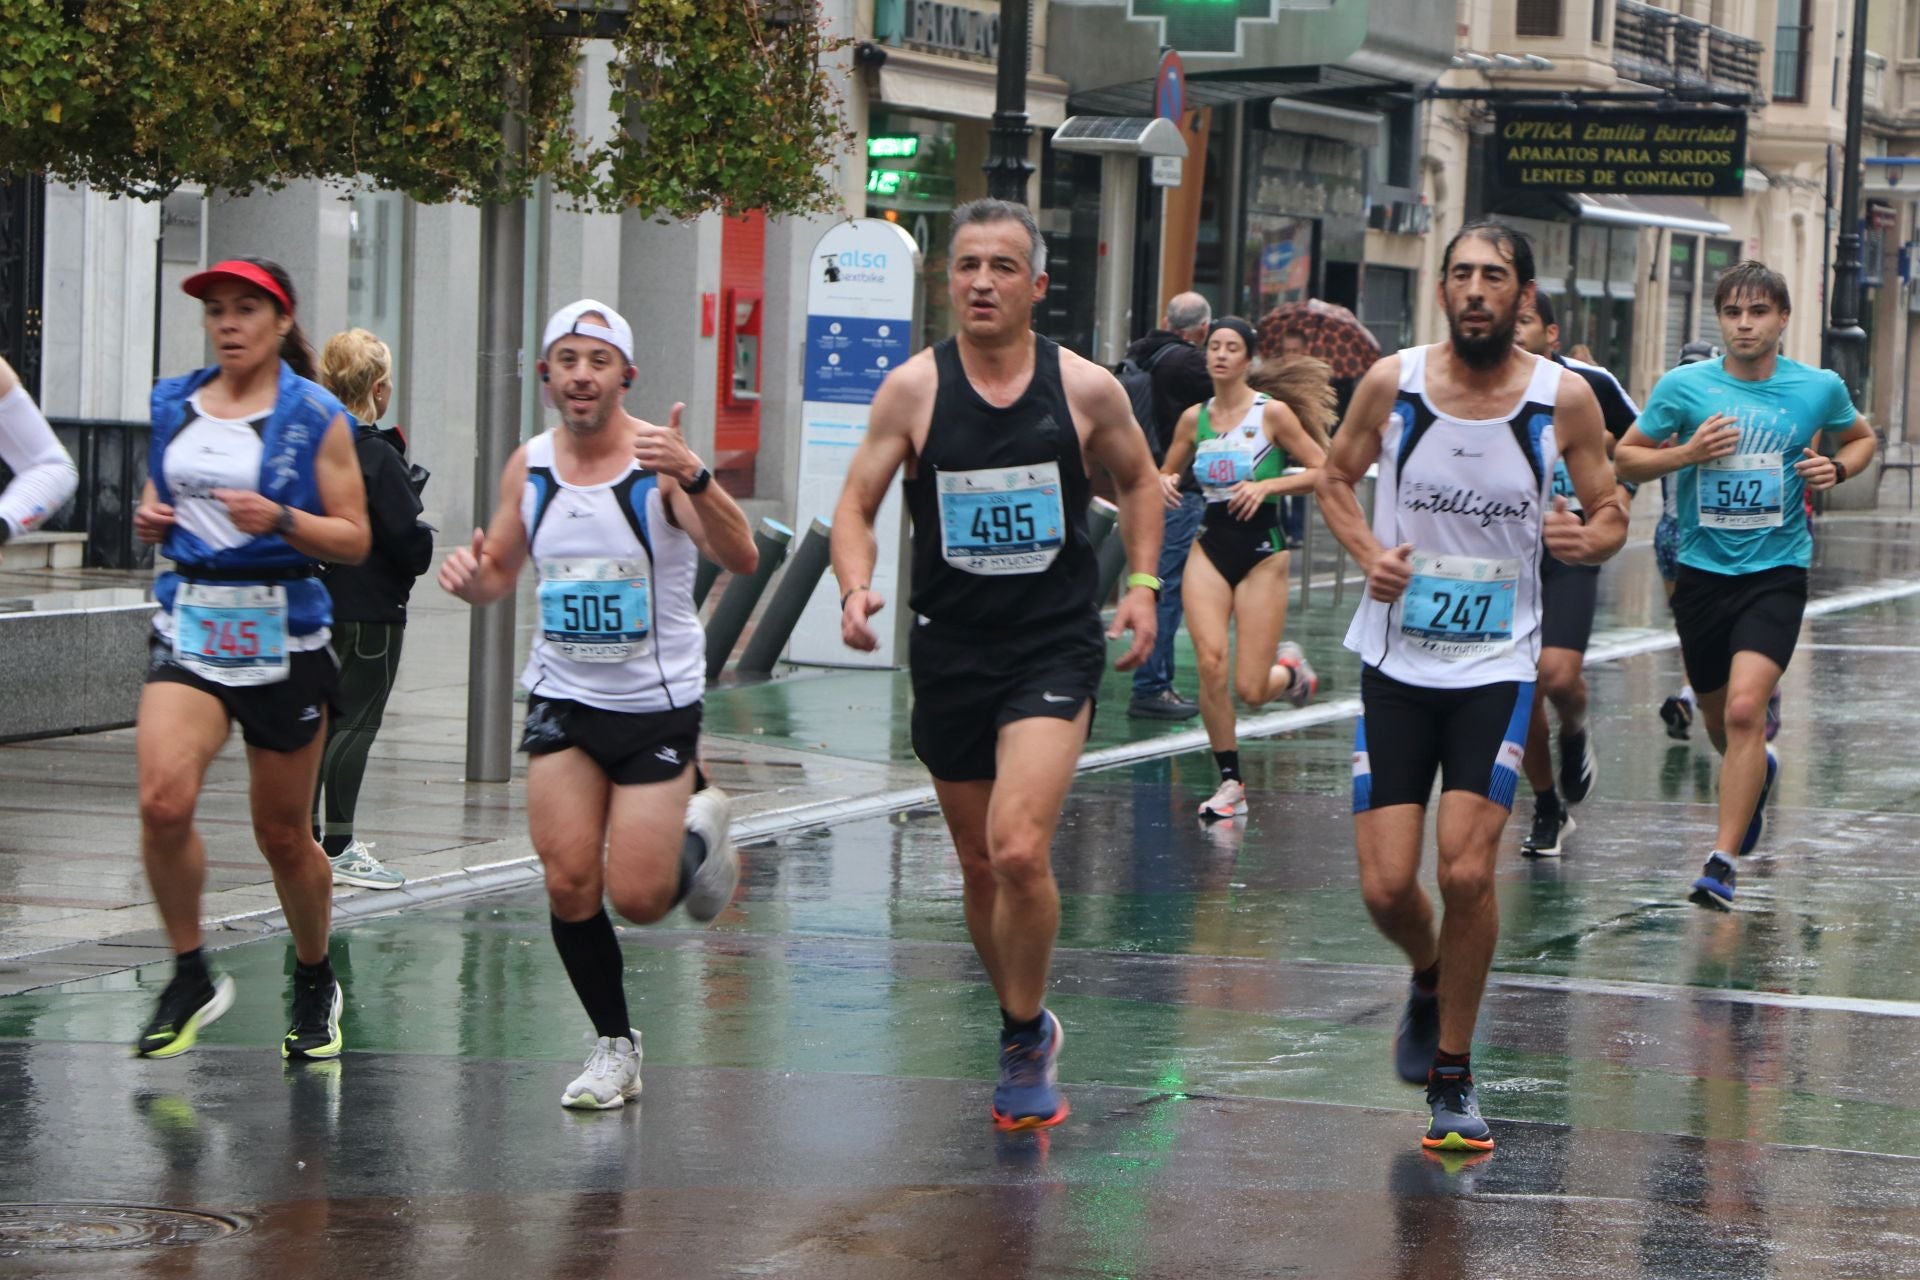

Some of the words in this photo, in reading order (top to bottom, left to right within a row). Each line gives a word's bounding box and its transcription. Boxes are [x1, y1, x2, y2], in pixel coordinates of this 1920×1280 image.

[913, 0, 1000, 58] FARMAC
[1583, 122, 1646, 142] Emilia
[1653, 124, 1737, 143] Barriada
[1507, 146, 1599, 162] APARATOS
[1604, 148, 1651, 163] PARA
[1659, 149, 1732, 165] SORDOS
[1521, 168, 1585, 184] LENTES
[1593, 169, 1617, 185] DE
[1623, 170, 1715, 187] CONTACTO
[839, 249, 887, 269] alsa
[1208, 458, 1236, 481] 481
[1717, 480, 1762, 507] 542
[1404, 489, 1530, 528] intelligent
[1728, 515, 1768, 523] HYUNDAI
[970, 503, 1035, 543] 495
[989, 554, 1048, 567] HYUNDAI
[562, 594, 622, 631] 505
[1429, 592, 1493, 631] 247
[201, 619, 259, 657] 245
[1441, 643, 1495, 655] HYUNDAI
